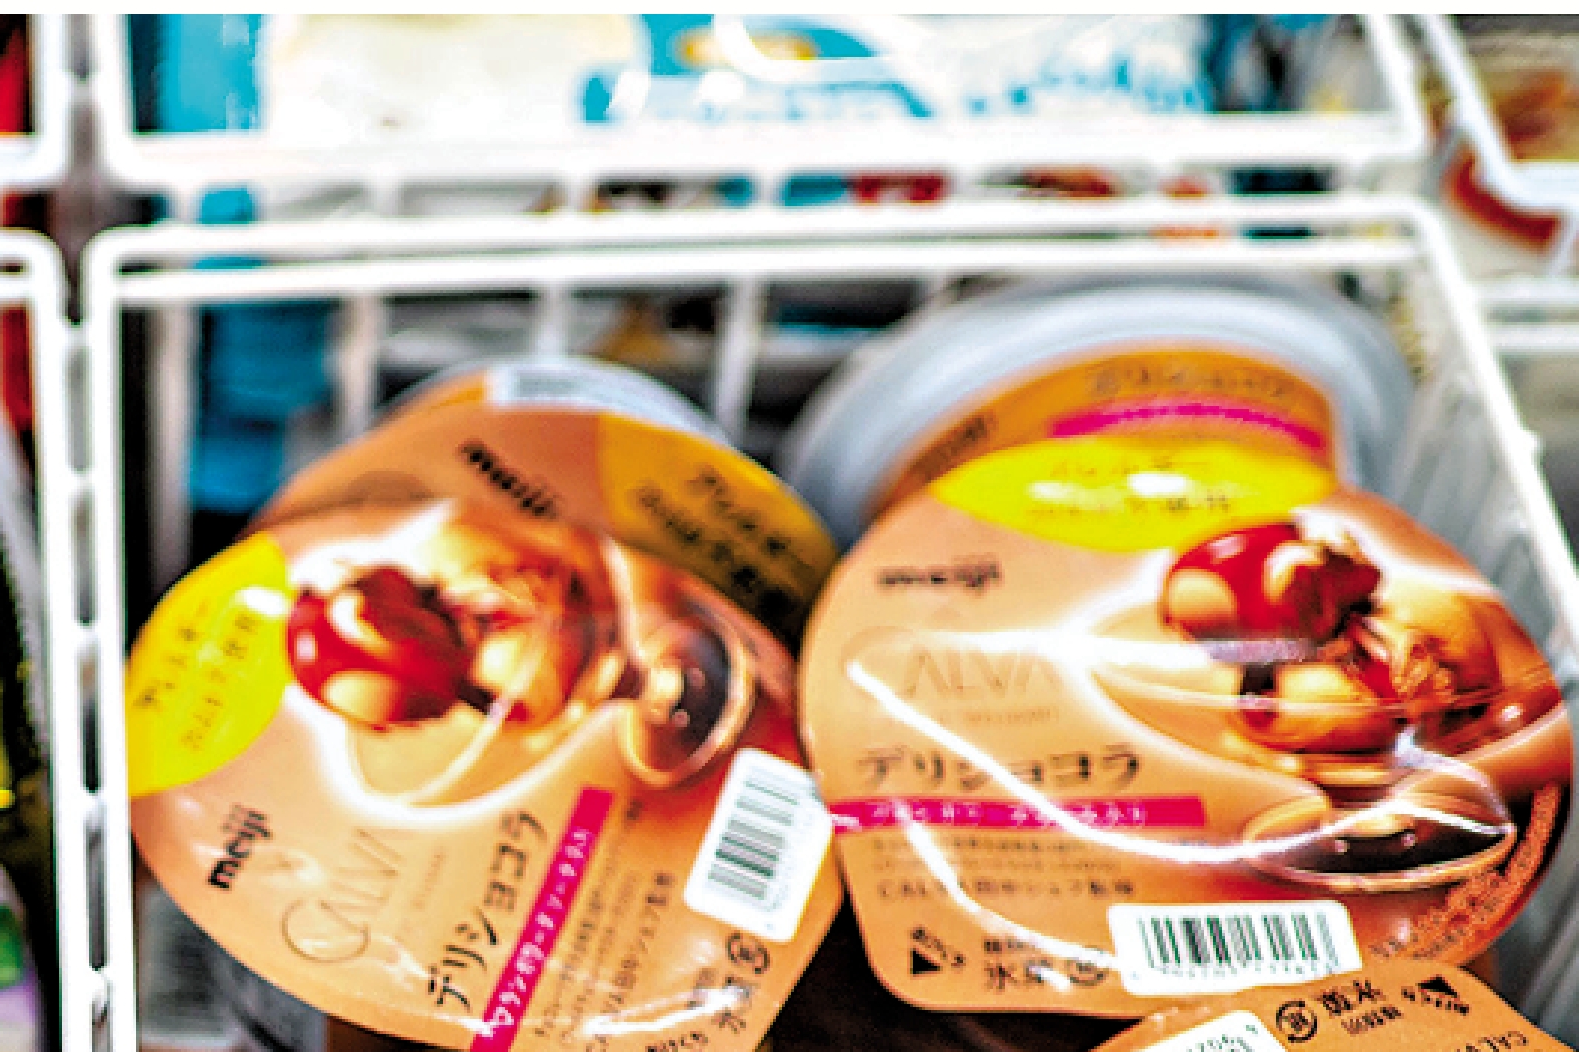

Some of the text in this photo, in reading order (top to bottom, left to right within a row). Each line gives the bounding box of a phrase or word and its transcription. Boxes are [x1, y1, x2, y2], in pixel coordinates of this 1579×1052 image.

[208, 804, 273, 890] meiji
[427, 810, 548, 1014] デリショコラ
